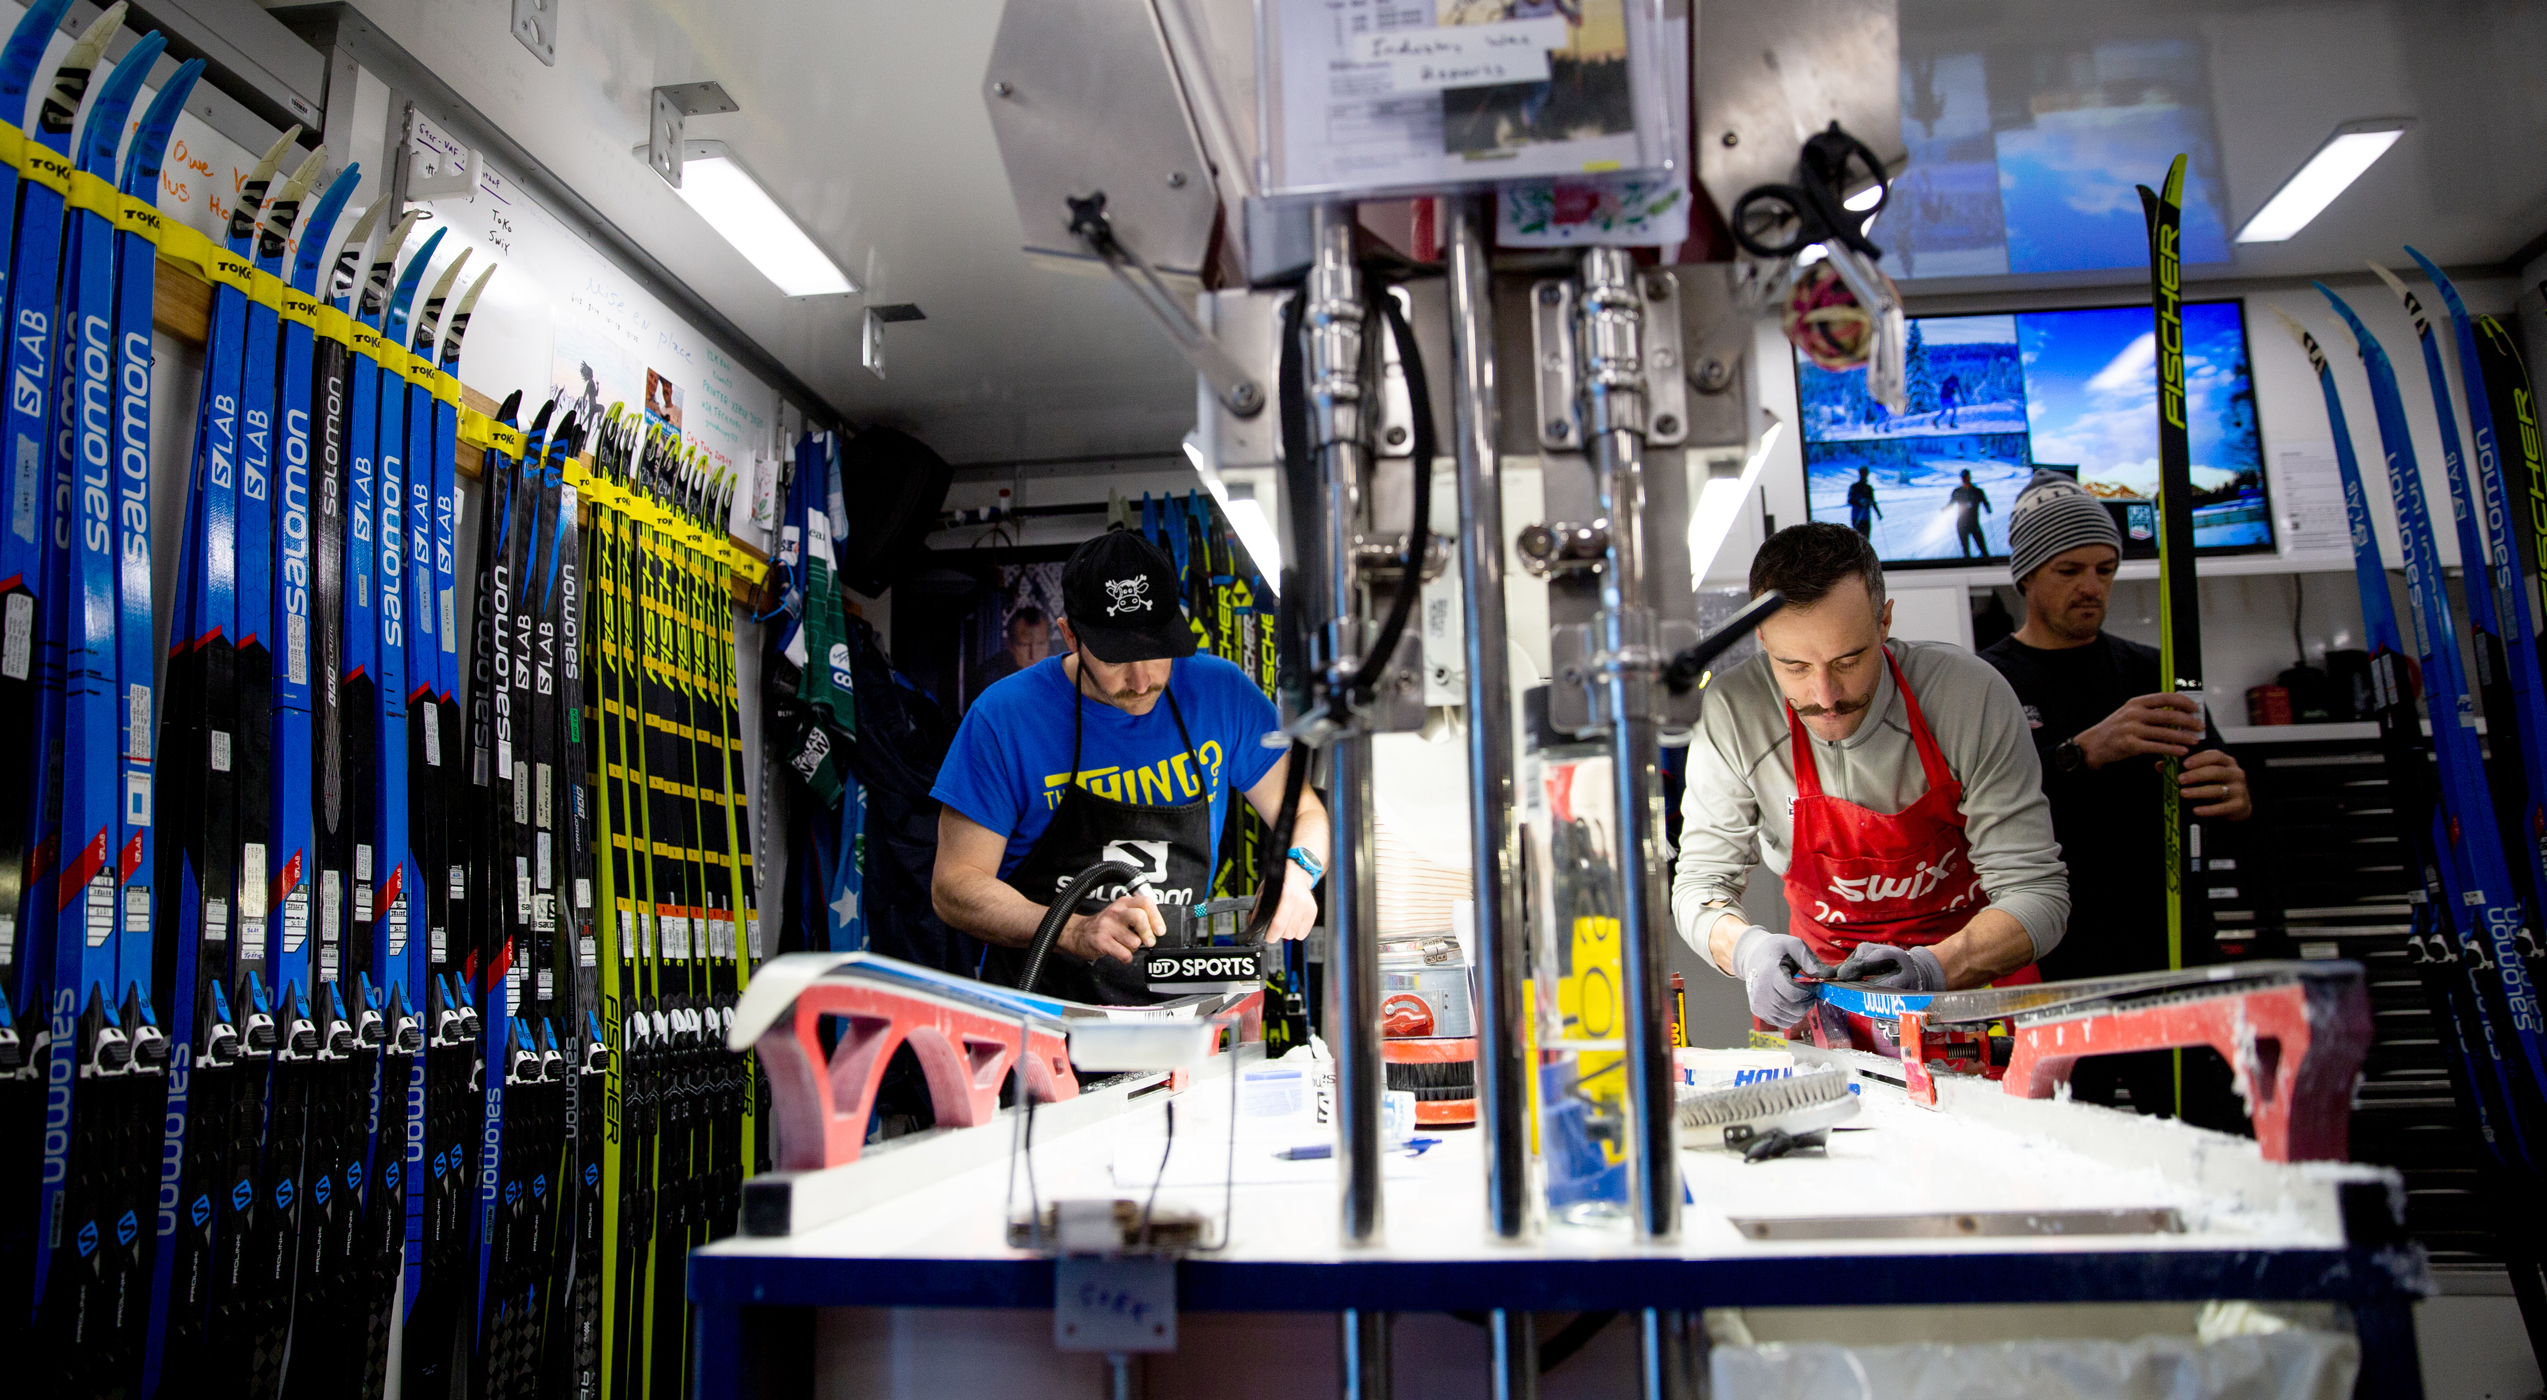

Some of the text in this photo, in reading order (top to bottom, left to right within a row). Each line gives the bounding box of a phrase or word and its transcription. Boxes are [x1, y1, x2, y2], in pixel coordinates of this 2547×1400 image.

[657, 331, 694, 366] place
[2159, 222, 2186, 430] FISCHER
[84, 315, 110, 555] salomon
[122, 331, 150, 567] salomon
[324, 376, 342, 518] salomon
[283, 409, 309, 616] salomon
[614, 496, 631, 507] TOK
[657, 517, 673, 526] TOK
[2477, 427, 2512, 590] salomon
[382, 455, 403, 648] salomon
[687, 534, 703, 544] TOK
[718, 548, 731, 558] TOK
[493, 564, 512, 742] salomon
[562, 563, 580, 680] salomon
[327, 621, 337, 707] LAB CLASSIC
[799, 736, 830, 782] NOW
[573, 814, 582, 852] CARBON
[576, 785, 586, 820] LAB
[1148, 957, 1256, 977] IDT SPORTS
[2486, 905, 2535, 1033] salomon
[42, 987, 75, 1184] salomon
[565, 1035, 577, 1140] salomon
[605, 993, 621, 1146] FISCHER
[156, 1041, 190, 1237] salomon
[482, 1086, 501, 1201] salomon
[231, 1233, 243, 1285] PROLINK
[274, 1230, 285, 1280] PROLINK
[314, 1225, 324, 1274] PROLINK
[345, 1209, 355, 1257] PROLINK
[116, 1271, 127, 1328] PROLINK
[189, 1250, 200, 1303] PROLINK
[76, 1285, 86, 1344] PROLINK
